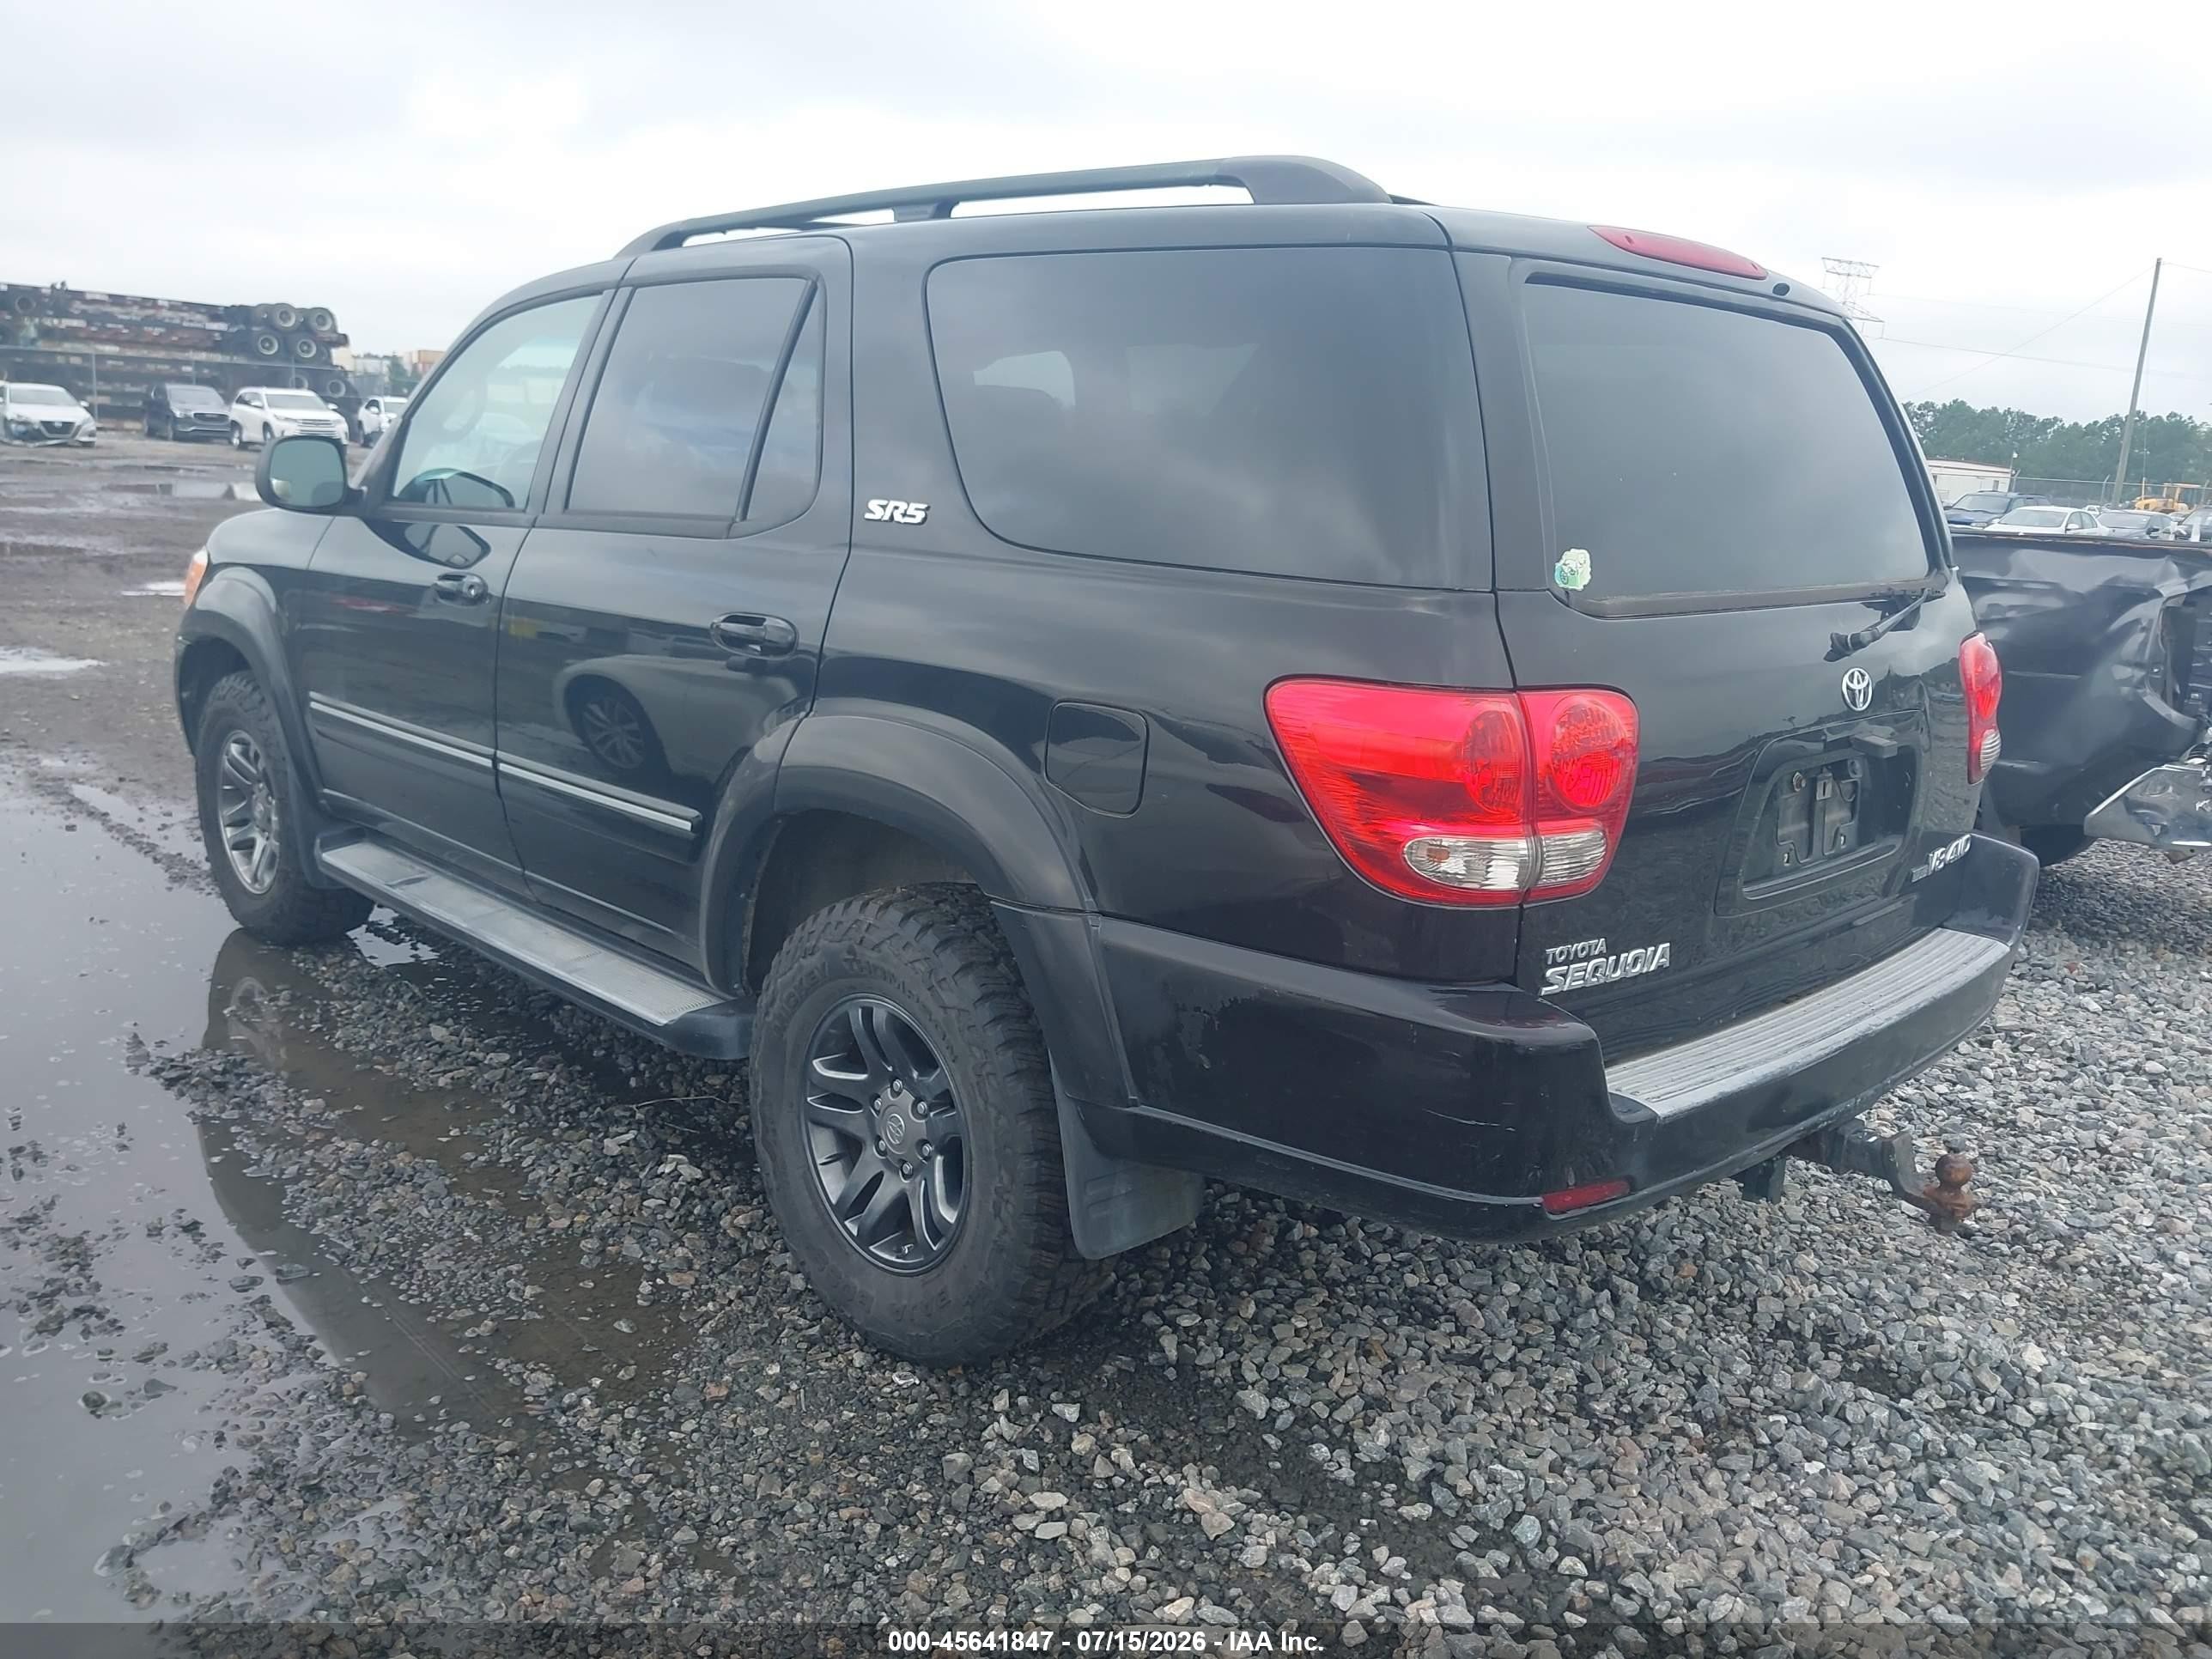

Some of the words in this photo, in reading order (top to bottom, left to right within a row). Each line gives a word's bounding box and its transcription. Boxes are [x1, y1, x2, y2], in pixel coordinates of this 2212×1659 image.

[864, 499, 930, 526] SR5
[1545, 938, 1607, 966] TOYOTA
[1539, 942, 1670, 997] SEQUOIA
